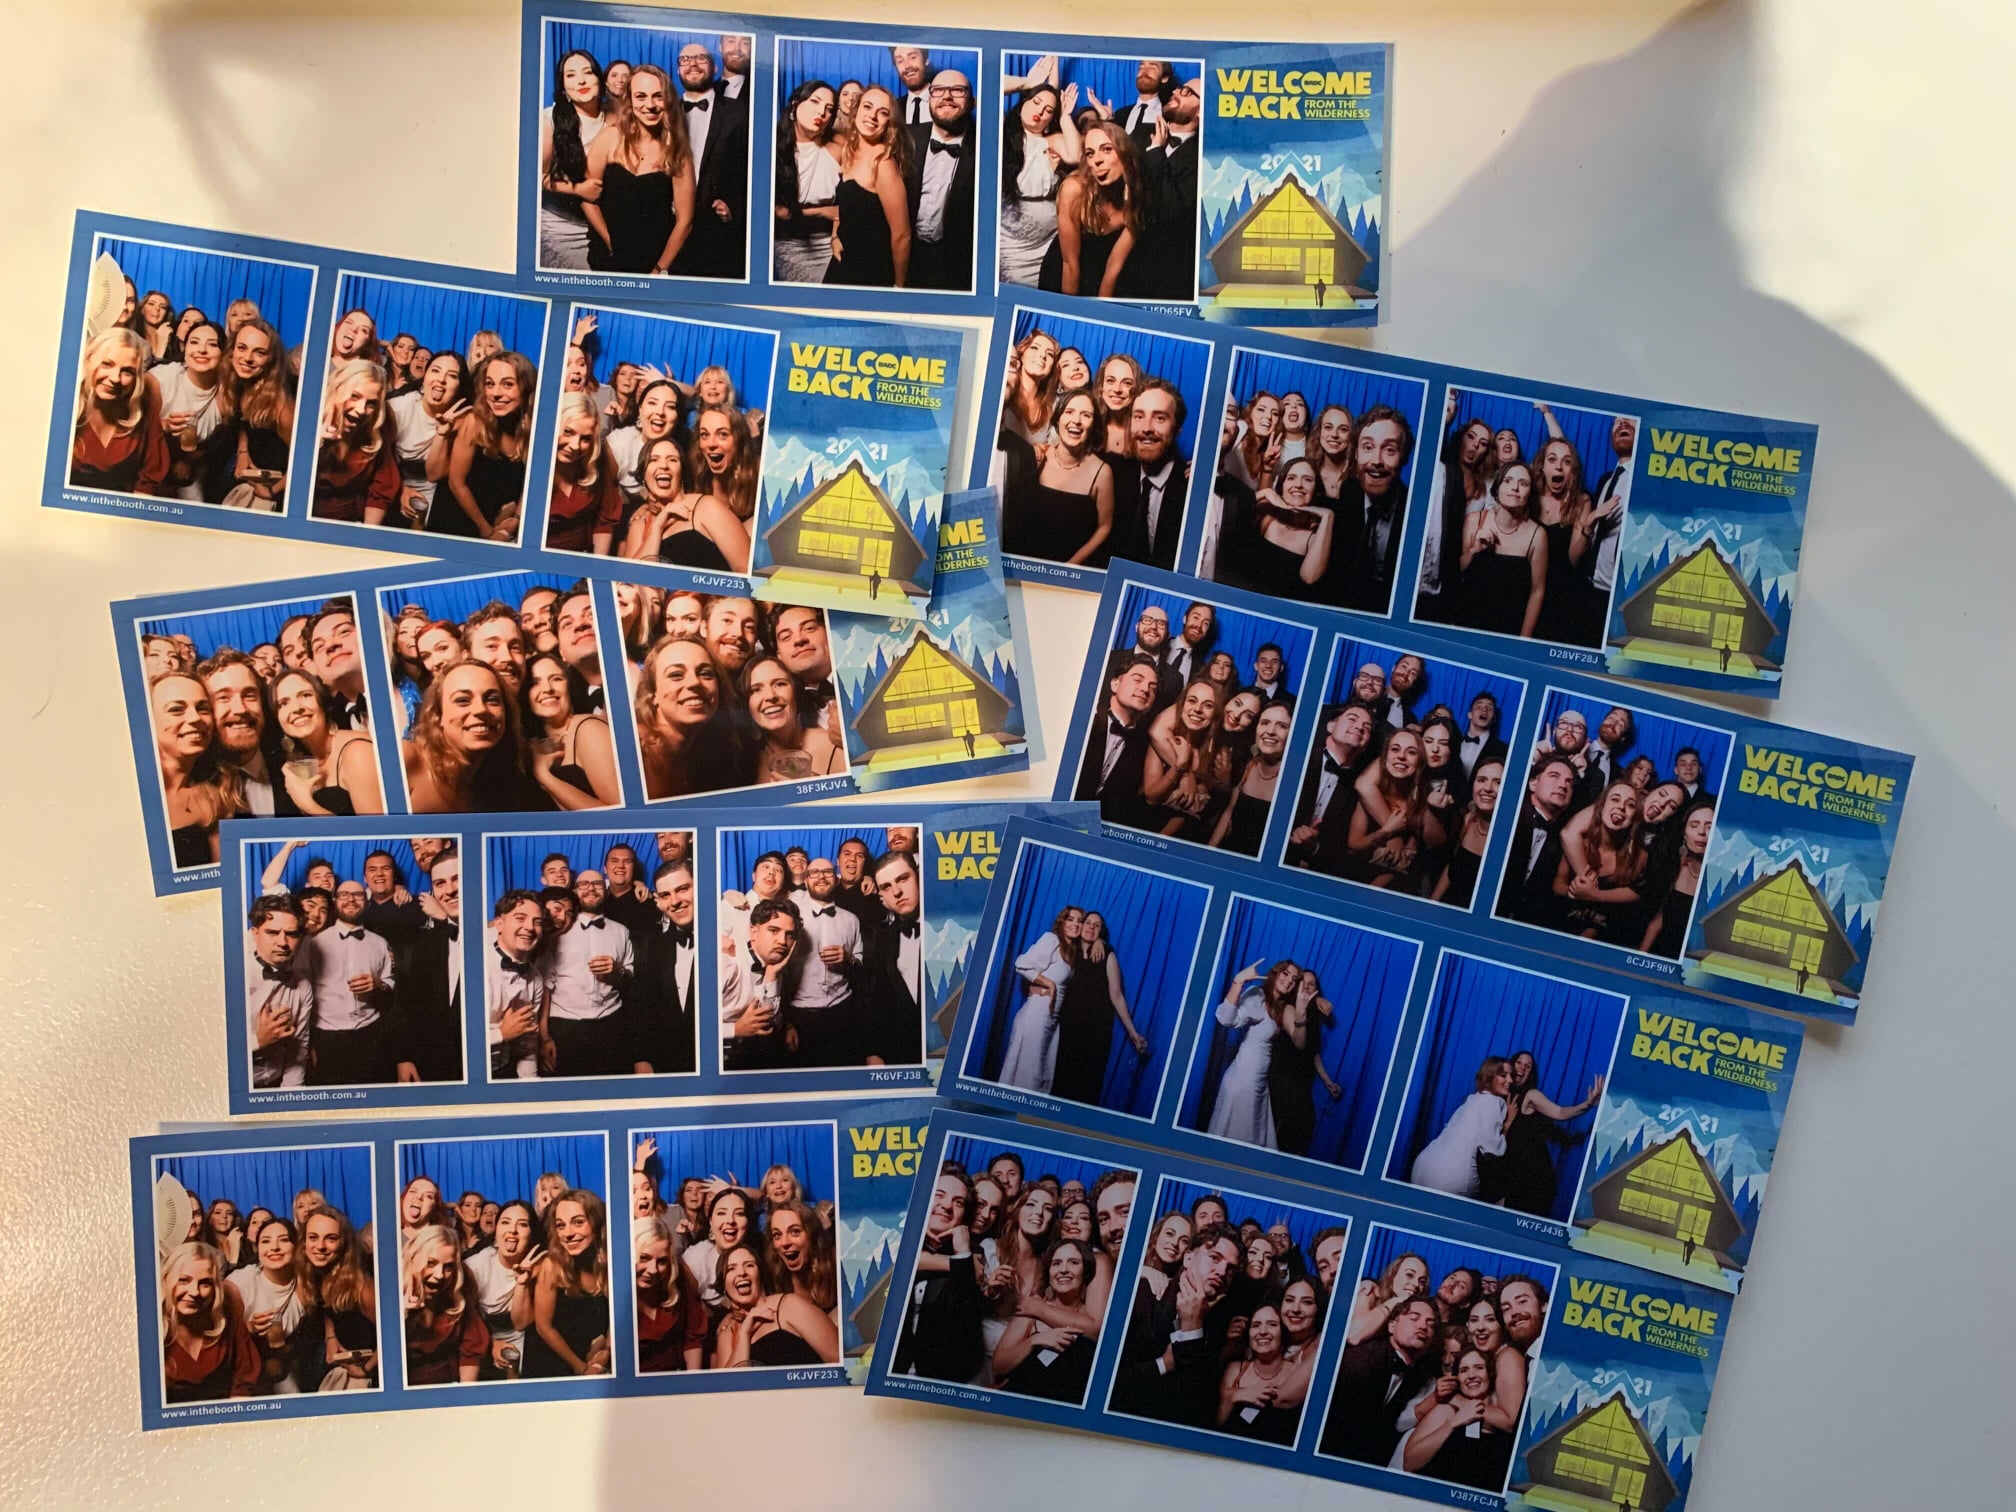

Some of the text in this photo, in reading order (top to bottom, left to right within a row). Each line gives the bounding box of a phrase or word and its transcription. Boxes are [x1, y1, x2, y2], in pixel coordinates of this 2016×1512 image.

[1216, 68, 1372, 96] WELCOME
[1218, 94, 1302, 120] BACK
[1304, 100, 1357, 109] FROM THE
[1304, 109, 1370, 118] WILDERNESS
[535, 275, 650, 288] www.inthebooth.com.au
[791, 342, 946, 384] WELCOME
[788, 368, 874, 402] BACK
[876, 382, 930, 396] FROM THE
[876, 392, 942, 408] WILDERNESS
[1651, 428, 1802, 473] WELCOME
[1648, 453, 1729, 488] BACK
[1732, 470, 1784, 485] FROM THE
[1731, 479, 1796, 496] WILDERNESS
[62, 492, 183, 514] www.inthebooth.com.au
[955, 548, 974, 560] THE
[692, 574, 745, 590] 6KJVF233
[1745, 744, 1896, 802] WELCOME
[796, 780, 848, 794] 38F3KJV4
[1738, 768, 1822, 810] BACK
[1822, 800, 1888, 824] WILDERNESS
[1823, 792, 1876, 812] FROM THE
[1638, 1008, 1788, 1070] WELCOME
[1631, 1034, 1714, 1076] BACK
[1714, 1067, 1778, 1092] WILDERNESS
[1715, 1058, 1767, 1079] FROM THE
[249, 1091, 367, 1104] www.inthebooth.com.au
[955, 1082, 1062, 1112] www.inthebooth.com.au
[1569, 1276, 1718, 1336] WELCOME
[1562, 1302, 1646, 1342] BACK
[1645, 1334, 1710, 1358] WILDERNESS
[1646, 1324, 1699, 1345] FROM THE
[884, 1379, 991, 1402] www.inthebooth.com.au
[161, 1402, 282, 1419] www.inthebooth.com.au
